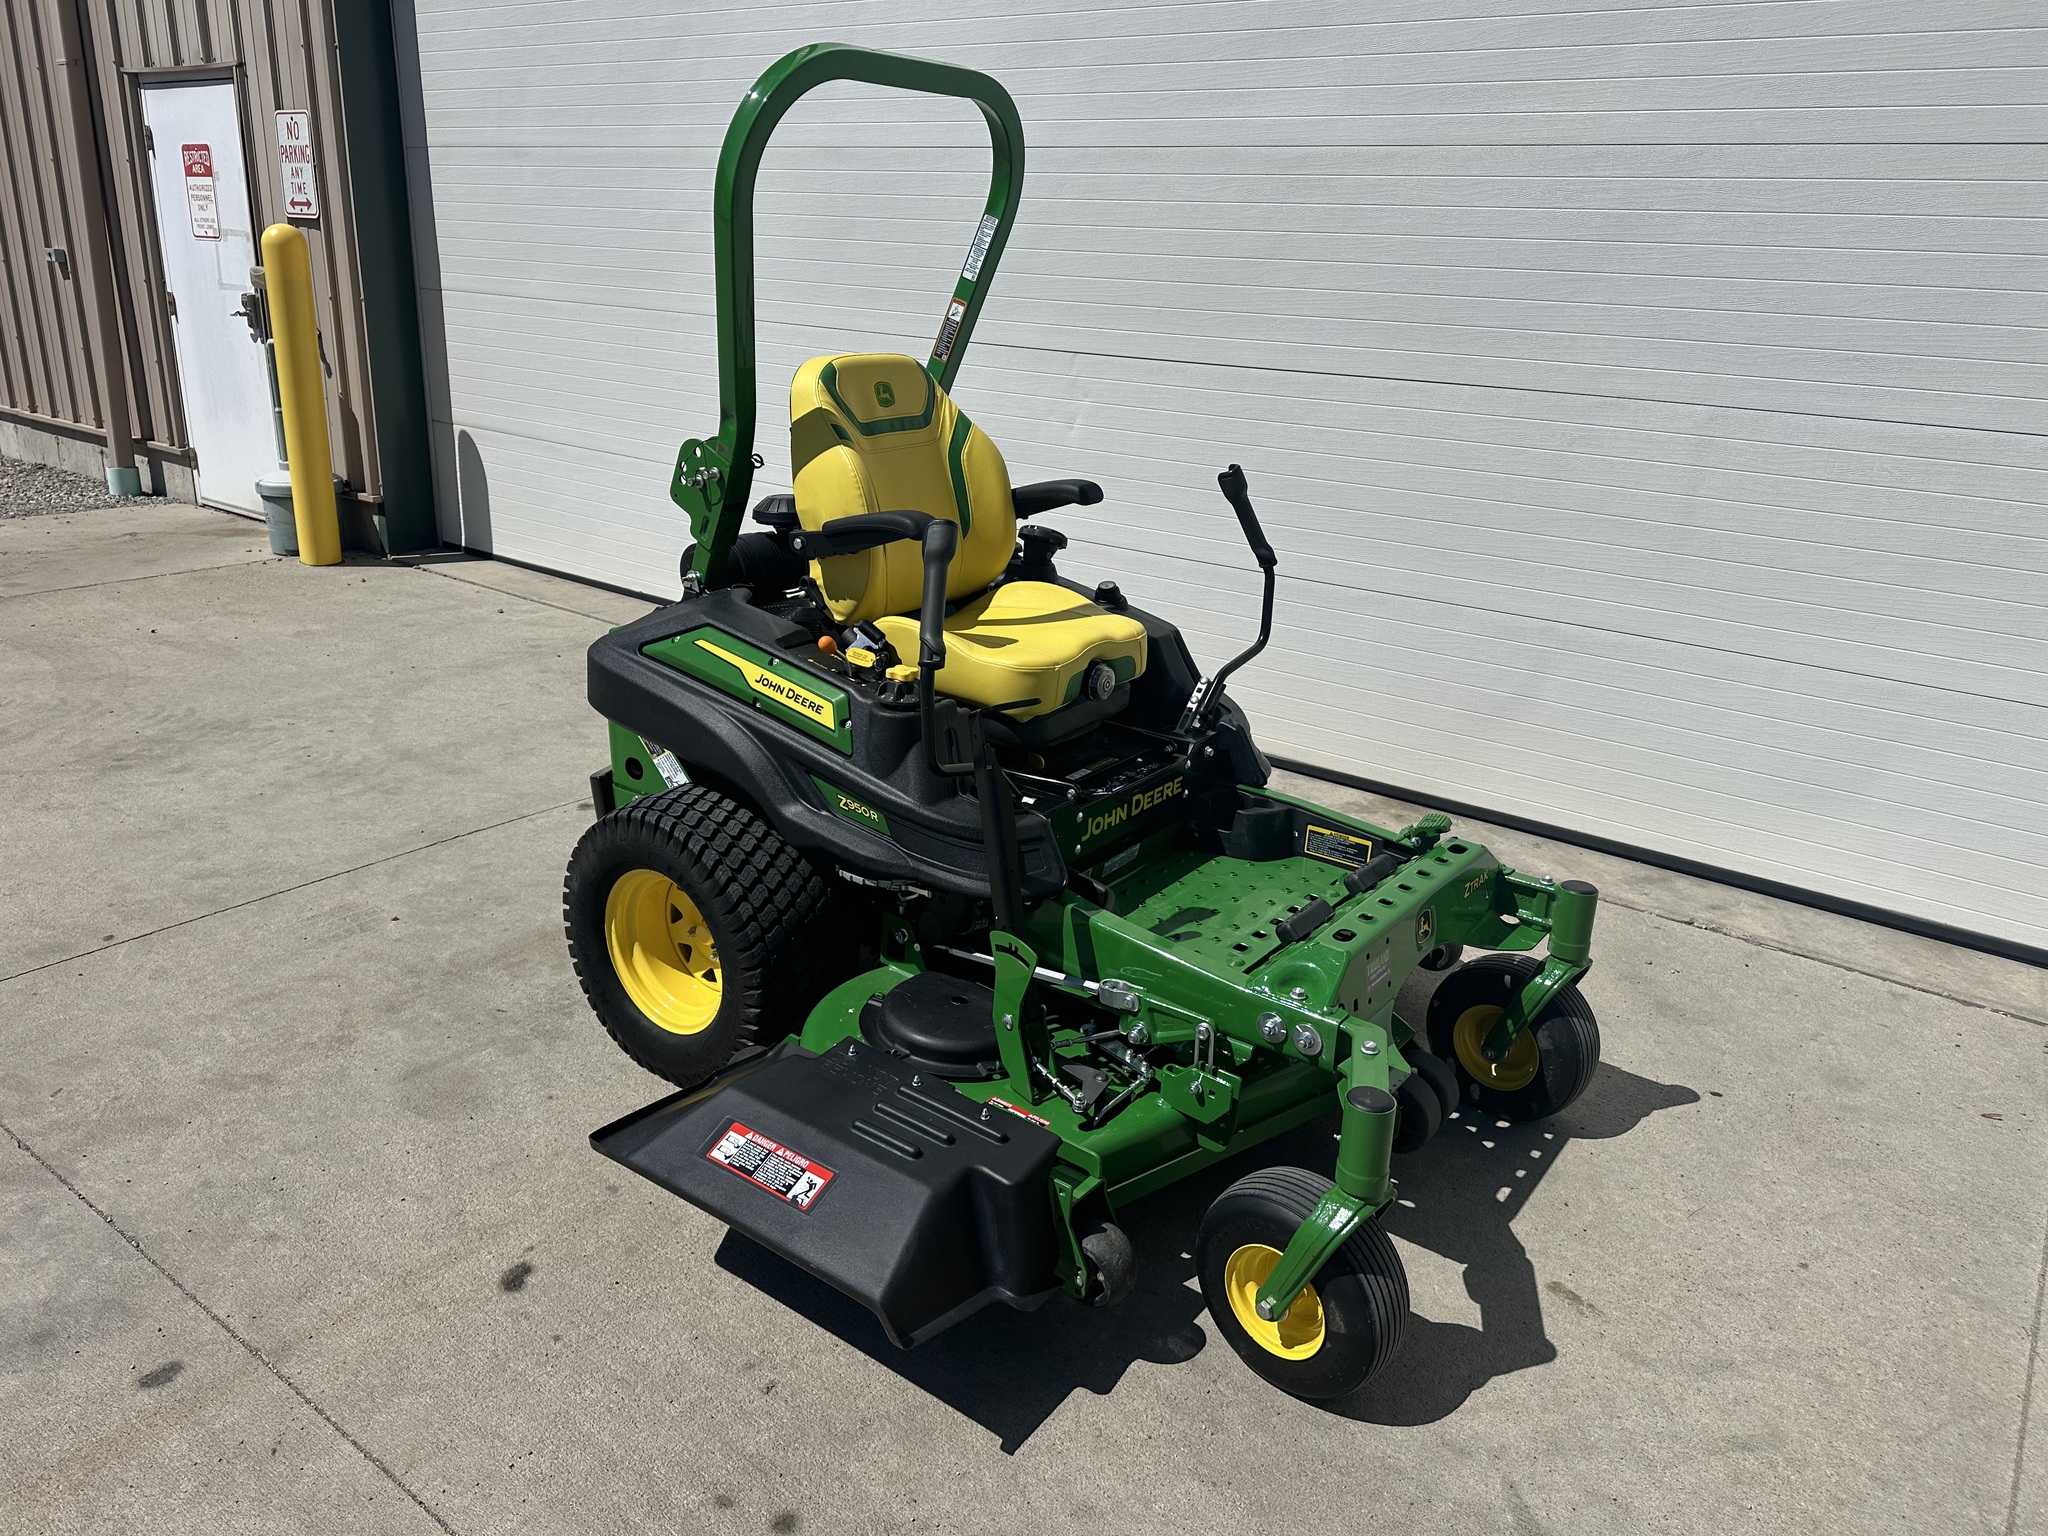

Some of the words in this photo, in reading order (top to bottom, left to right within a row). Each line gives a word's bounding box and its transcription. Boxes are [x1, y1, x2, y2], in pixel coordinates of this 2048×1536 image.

[286, 121, 300, 140] NO
[183, 150, 210, 167] RESTRICTED
[280, 144, 310, 164] PARKING
[192, 164, 205, 173] AREA
[290, 166, 304, 179] ANY
[189, 184, 213, 192] AUTHORIZED
[290, 181, 308, 195] TIME
[190, 193, 213, 202] PERSONNEL
[197, 204, 209, 212] ONLY
[754, 673, 786, 697] JOHN
[786, 687, 824, 715] DEERE
[837, 794, 879, 823] Z950R
[1082, 803, 1128, 841] JOHN
[1131, 776, 1183, 816] DEERE
[1464, 869, 1489, 899] ZTRAK
[752, 1134, 777, 1151] DANGER
[782, 1150, 810, 1168] PELIGRO
